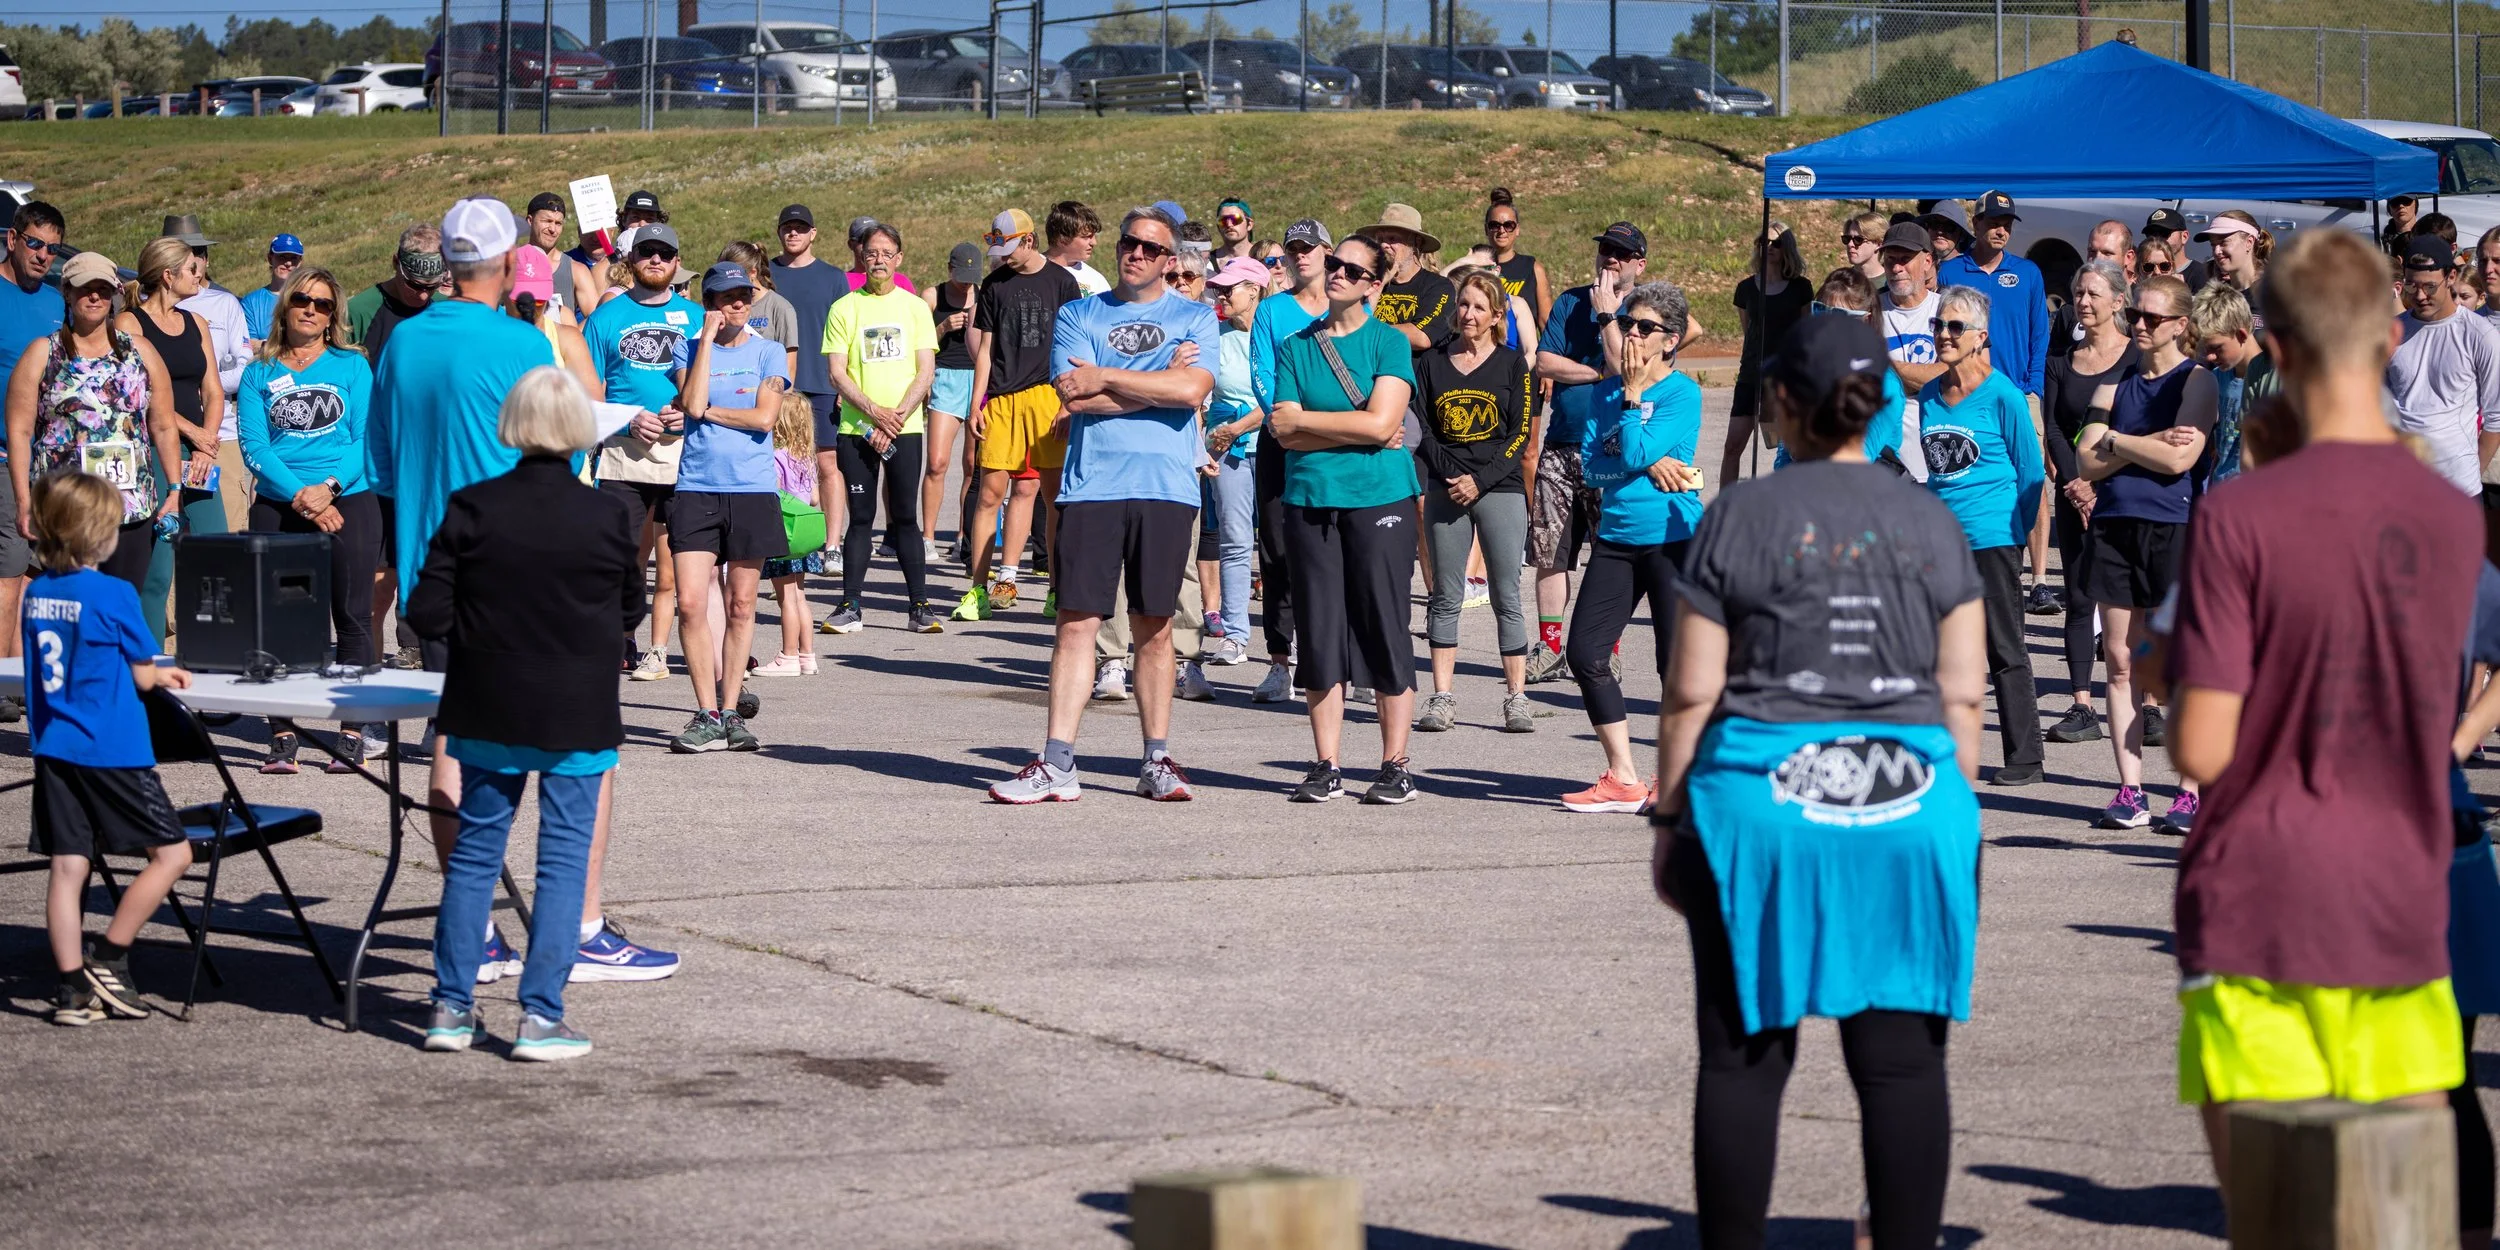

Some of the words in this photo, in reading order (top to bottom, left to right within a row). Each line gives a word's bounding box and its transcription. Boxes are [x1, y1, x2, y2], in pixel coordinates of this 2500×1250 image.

[1462, 388, 1490, 398] Memorial
[1523, 372, 1531, 394] TOM
[37, 630, 65, 694] 3
